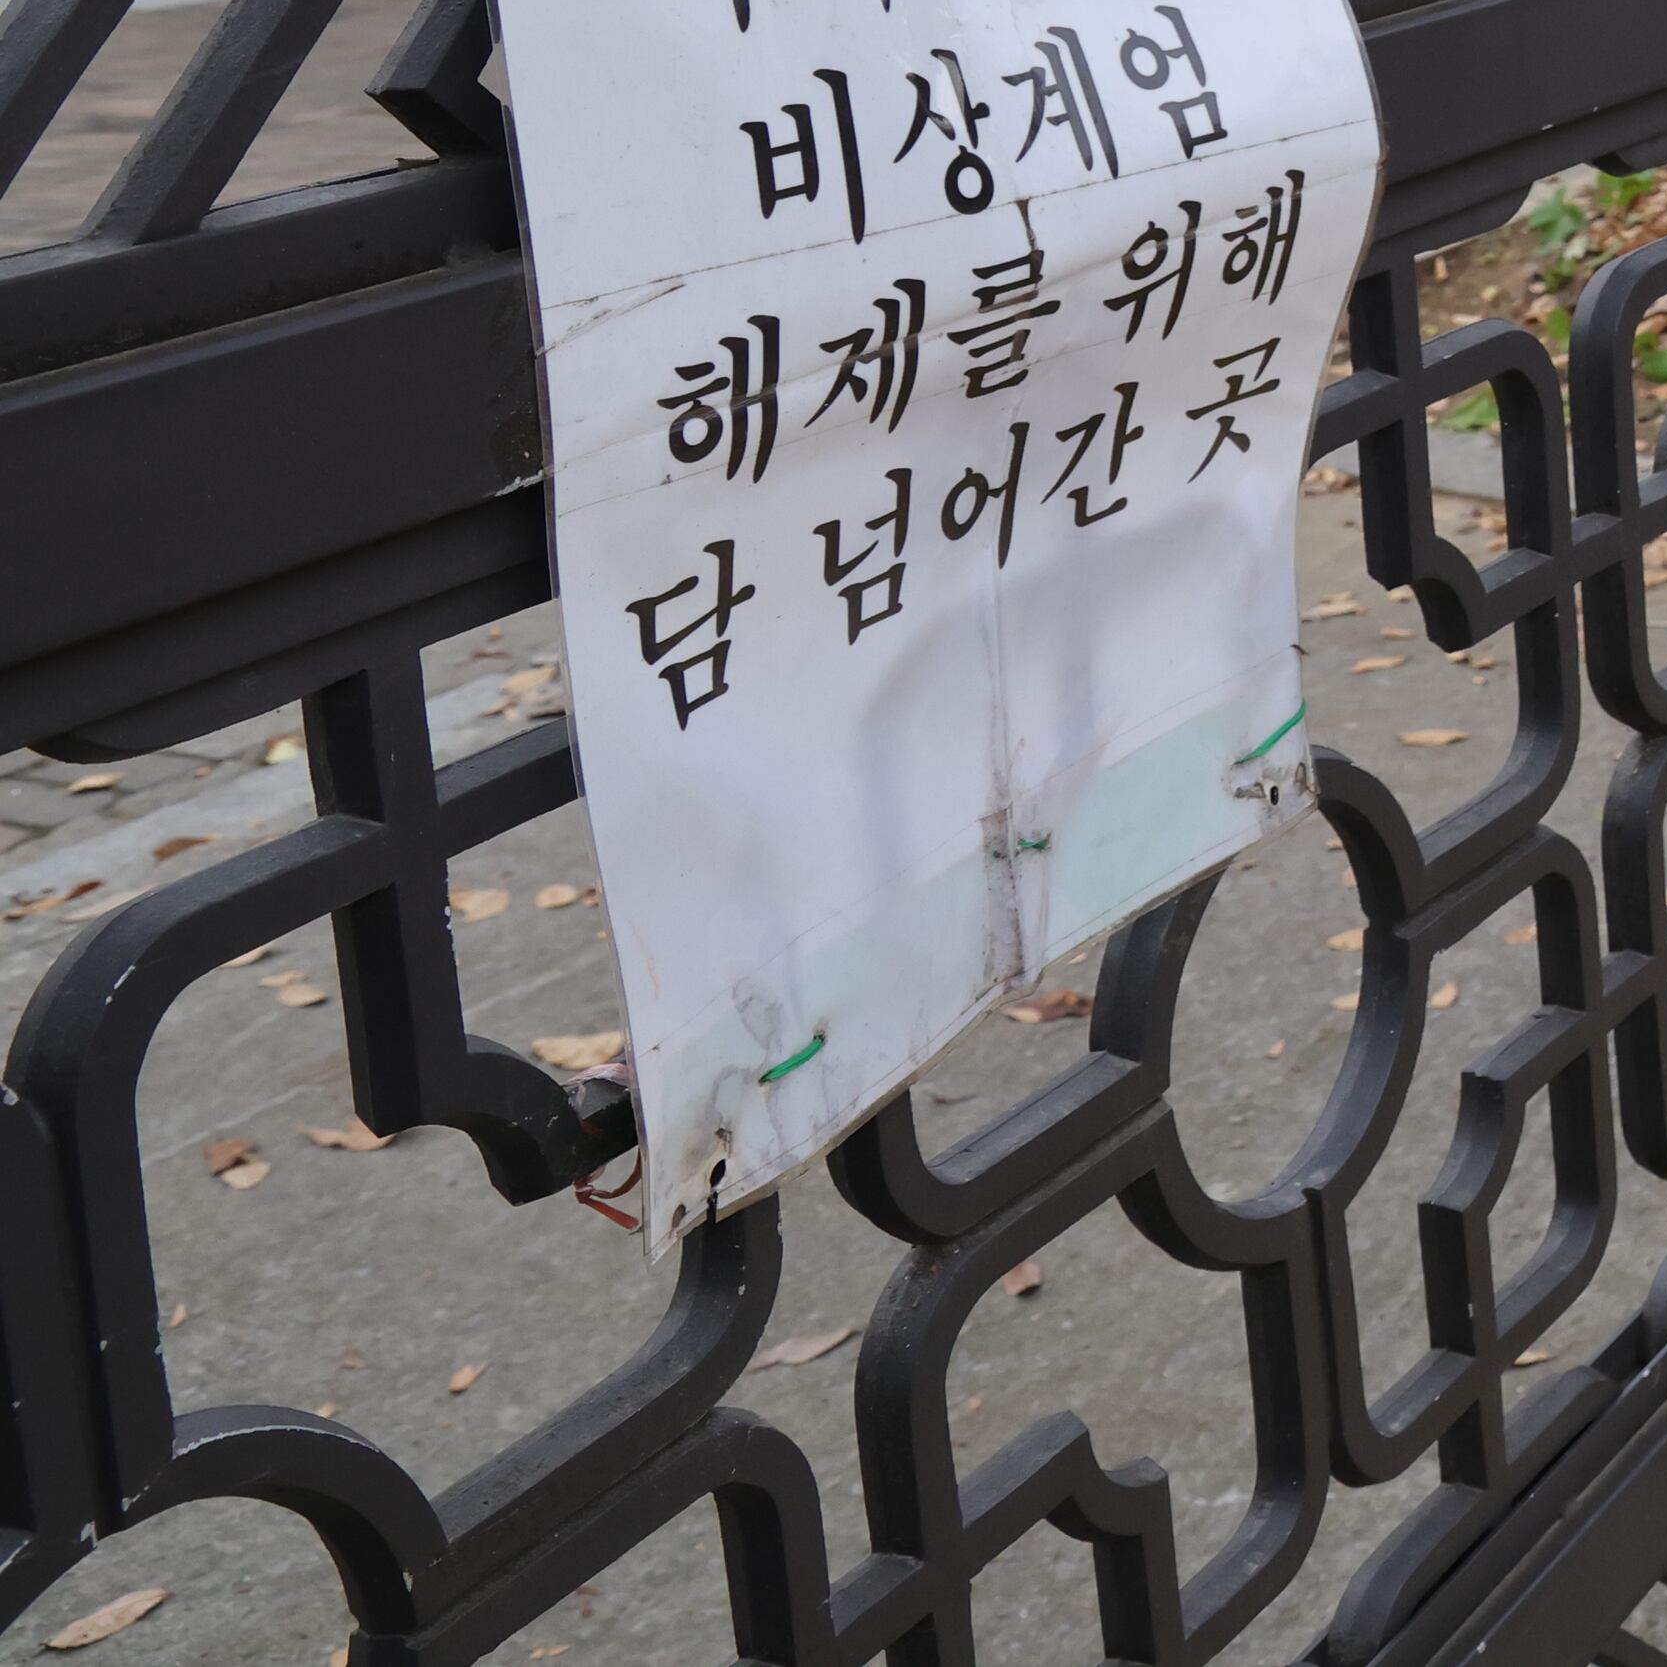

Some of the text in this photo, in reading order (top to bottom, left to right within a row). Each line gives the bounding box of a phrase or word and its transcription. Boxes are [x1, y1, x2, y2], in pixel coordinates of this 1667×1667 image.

[739, 4, 1228, 246] 비상계엄
[656, 168, 1306, 485] 해제를 위해
[624, 336, 1281, 732] 담 넘어간 곳
